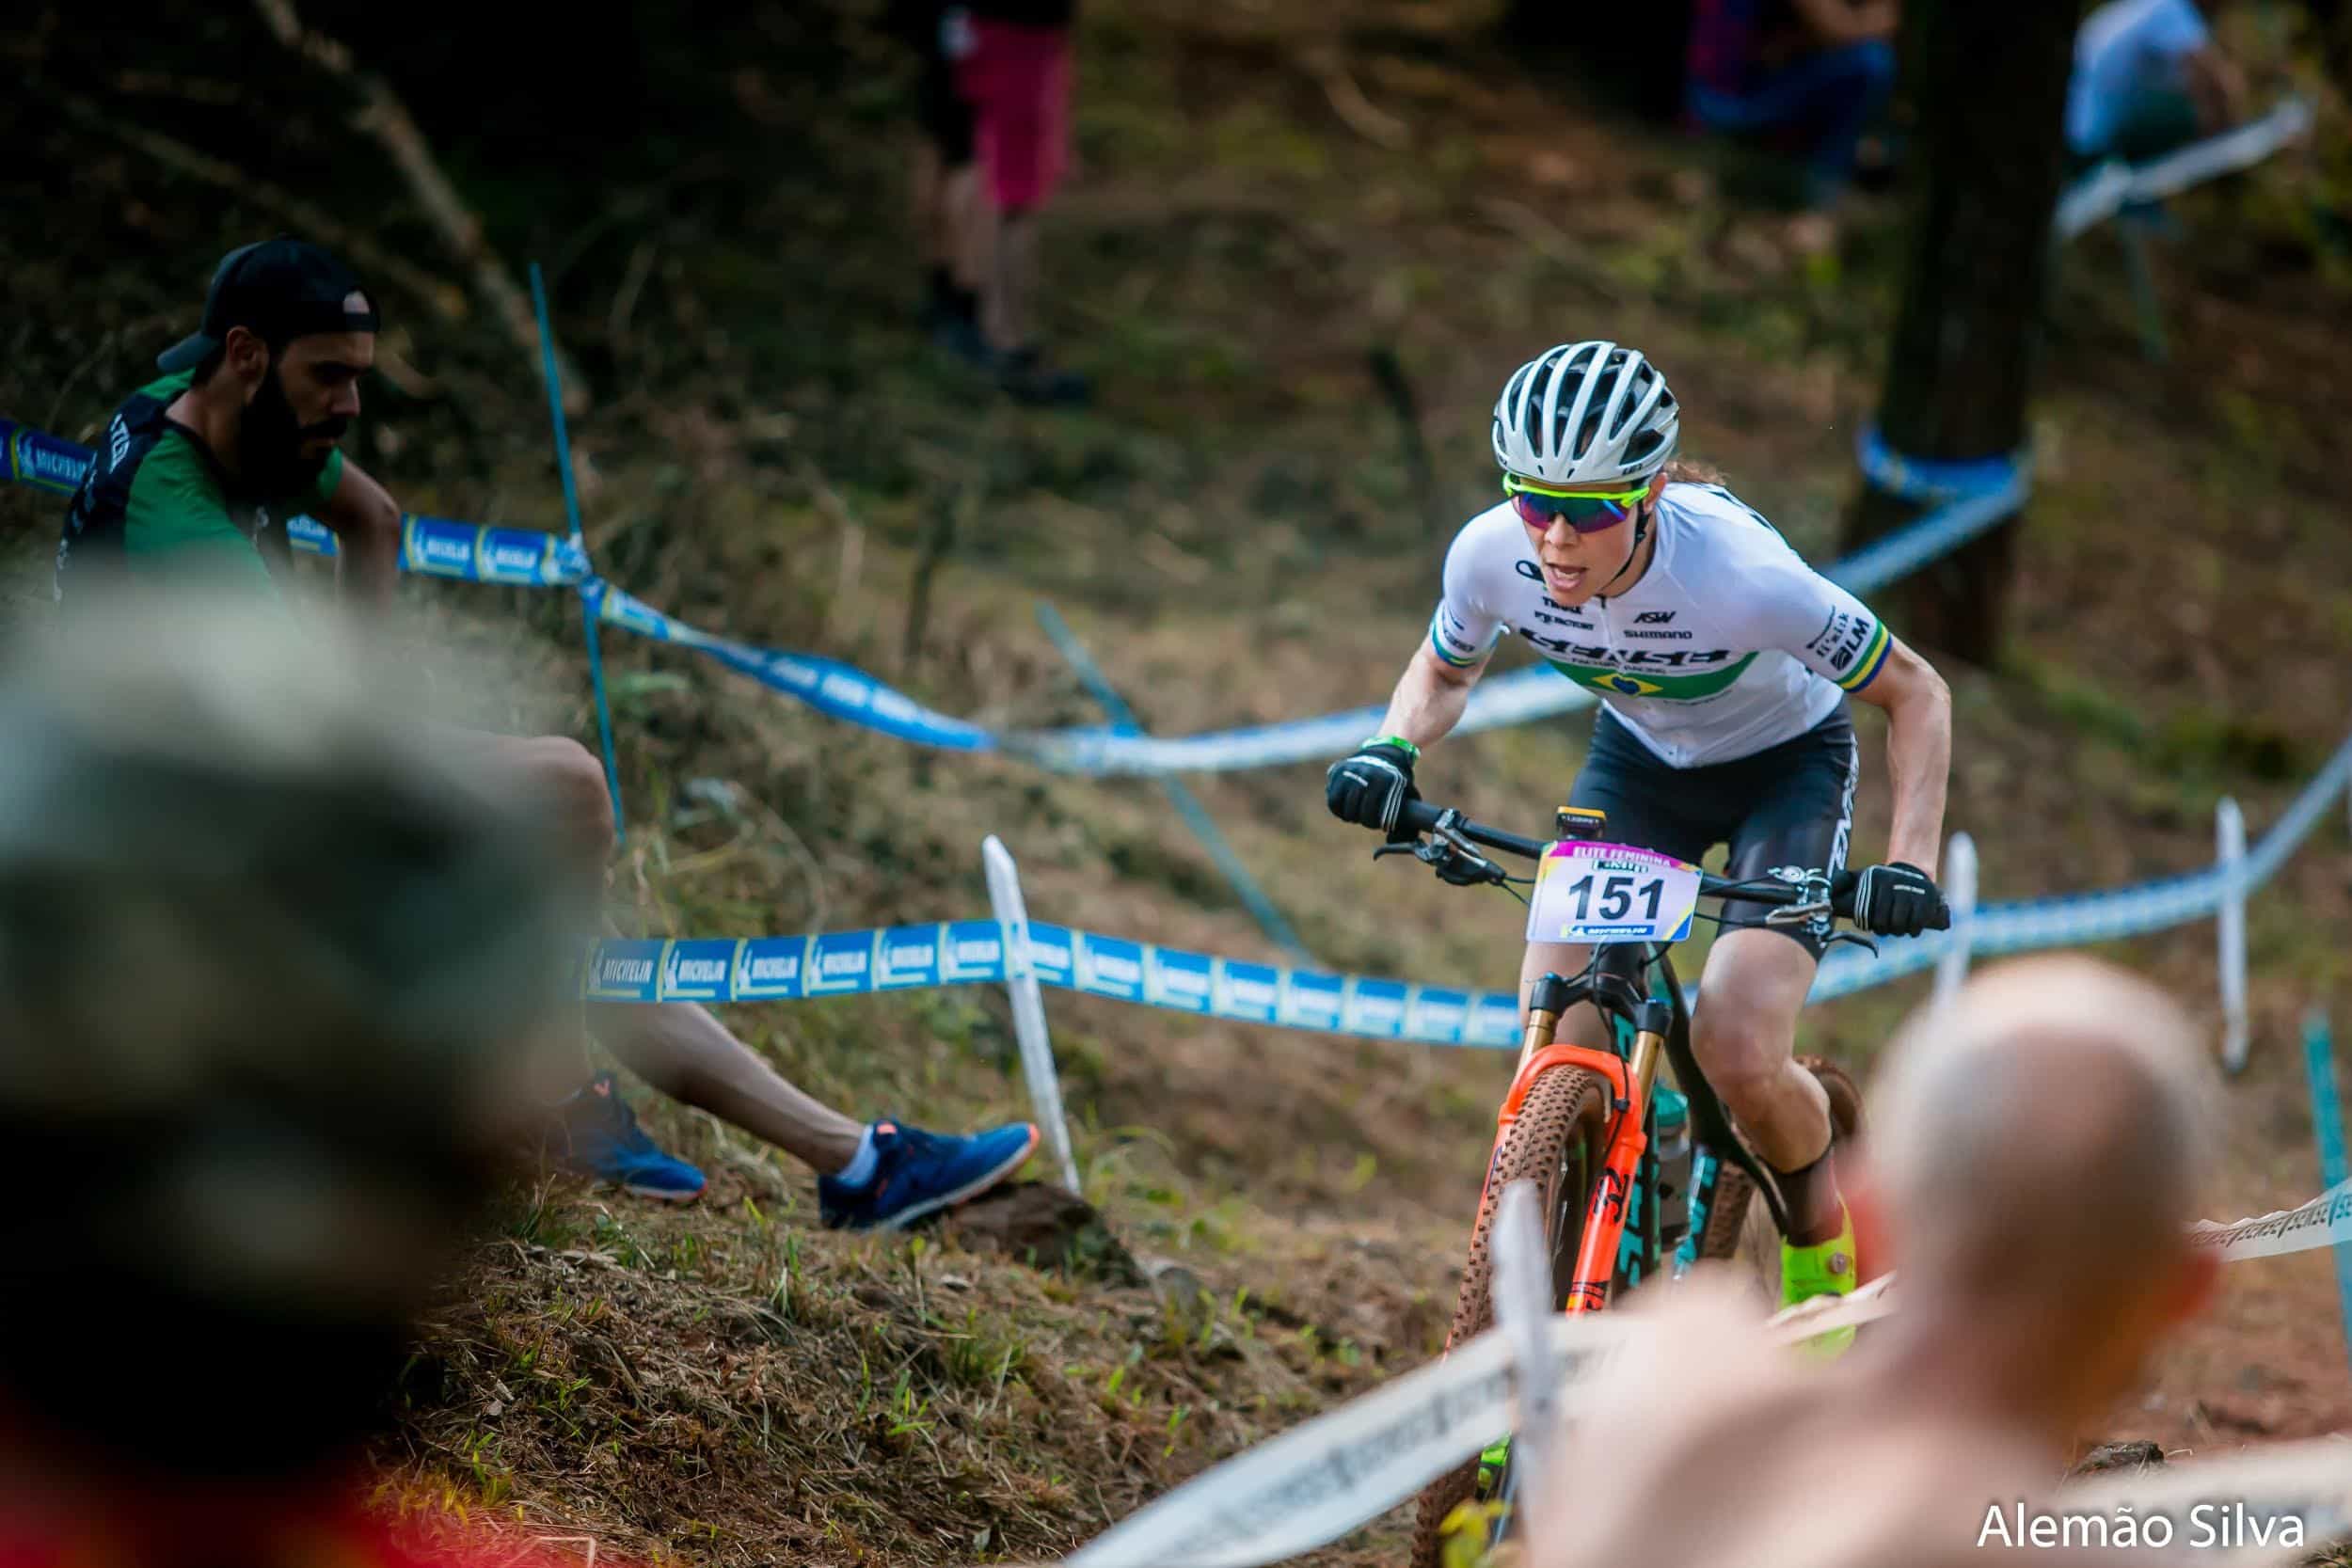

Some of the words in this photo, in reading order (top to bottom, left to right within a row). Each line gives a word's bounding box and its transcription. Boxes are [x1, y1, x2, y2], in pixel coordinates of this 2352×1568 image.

[1623, 629, 1692, 640] SHIMANO
[1573, 846, 1607, 859] ELITE
[1609, 847, 1671, 867] FEMININA
[1568, 875, 1664, 921] 151
[601, 959, 654, 983] MICHELIN
